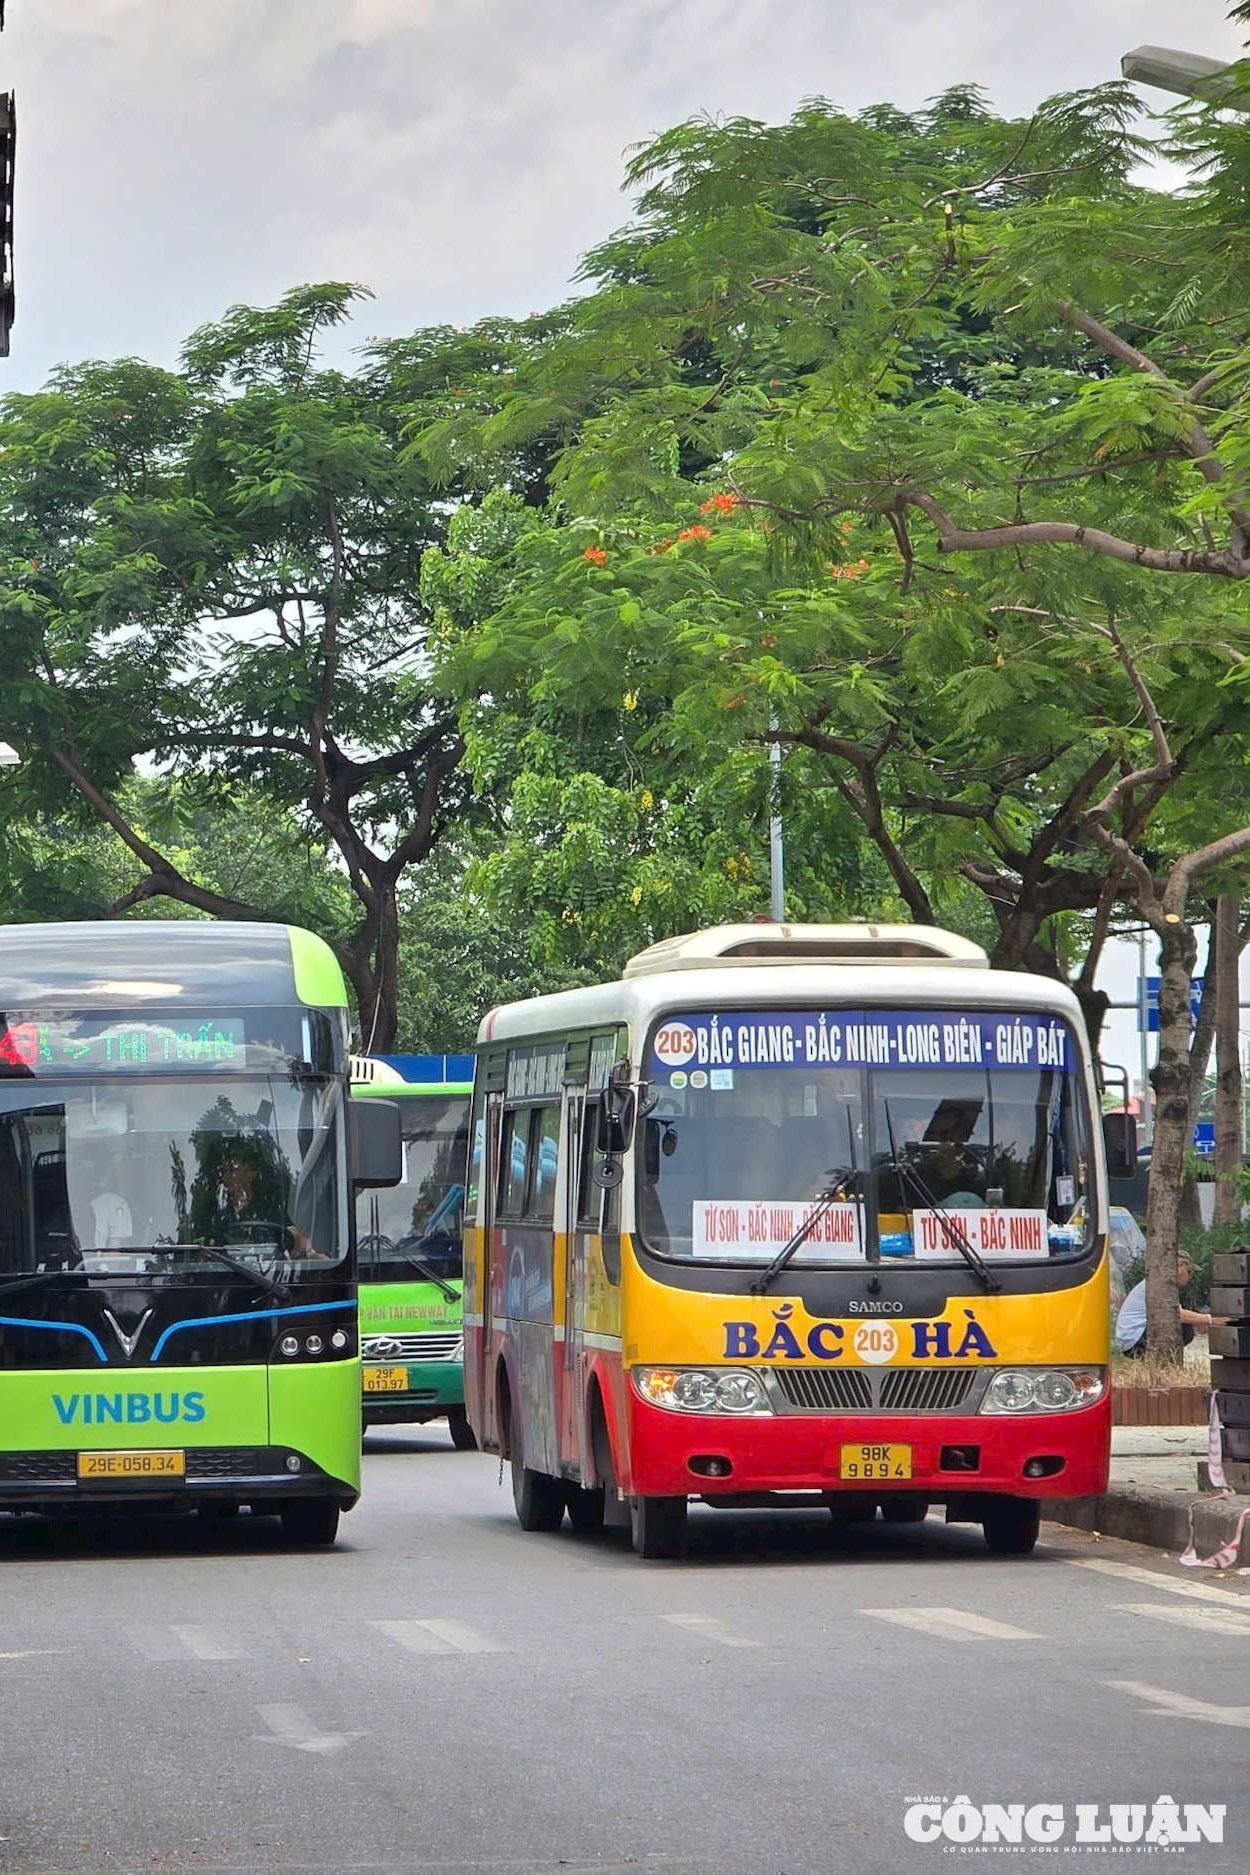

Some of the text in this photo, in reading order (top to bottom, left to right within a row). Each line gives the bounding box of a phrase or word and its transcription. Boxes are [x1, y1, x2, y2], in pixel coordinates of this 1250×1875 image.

[658, 1030, 695, 1055] 203
[697, 1014, 734, 1064] BẮC
[805, 1013, 842, 1062] BẮC
[943, 1018, 983, 1063] BIÊN
[996, 1018, 1034, 1064] GIÁP
[1037, 1019, 1066, 1066] BÁT
[705, 1203, 718, 1242] TỪ
[719, 1207, 739, 1242] SƠN
[749, 1204, 767, 1242] BẮC
[770, 1209, 794, 1243] NINH
[825, 1209, 855, 1244] GIANG
[921, 1211, 938, 1251] TỪ
[980, 1209, 1006, 1250] BẮC
[1010, 1217, 1042, 1250] NINH
[848, 1301, 904, 1313] SAMCO
[723, 1303, 999, 1360] BẮC 203 HÀ
[376, 1369, 395, 1379] 29F
[51, 1391, 206, 1425] VINBUS
[88, 1456, 176, 1472] 29E-058.34
[861, 1447, 891, 1461] 98K
